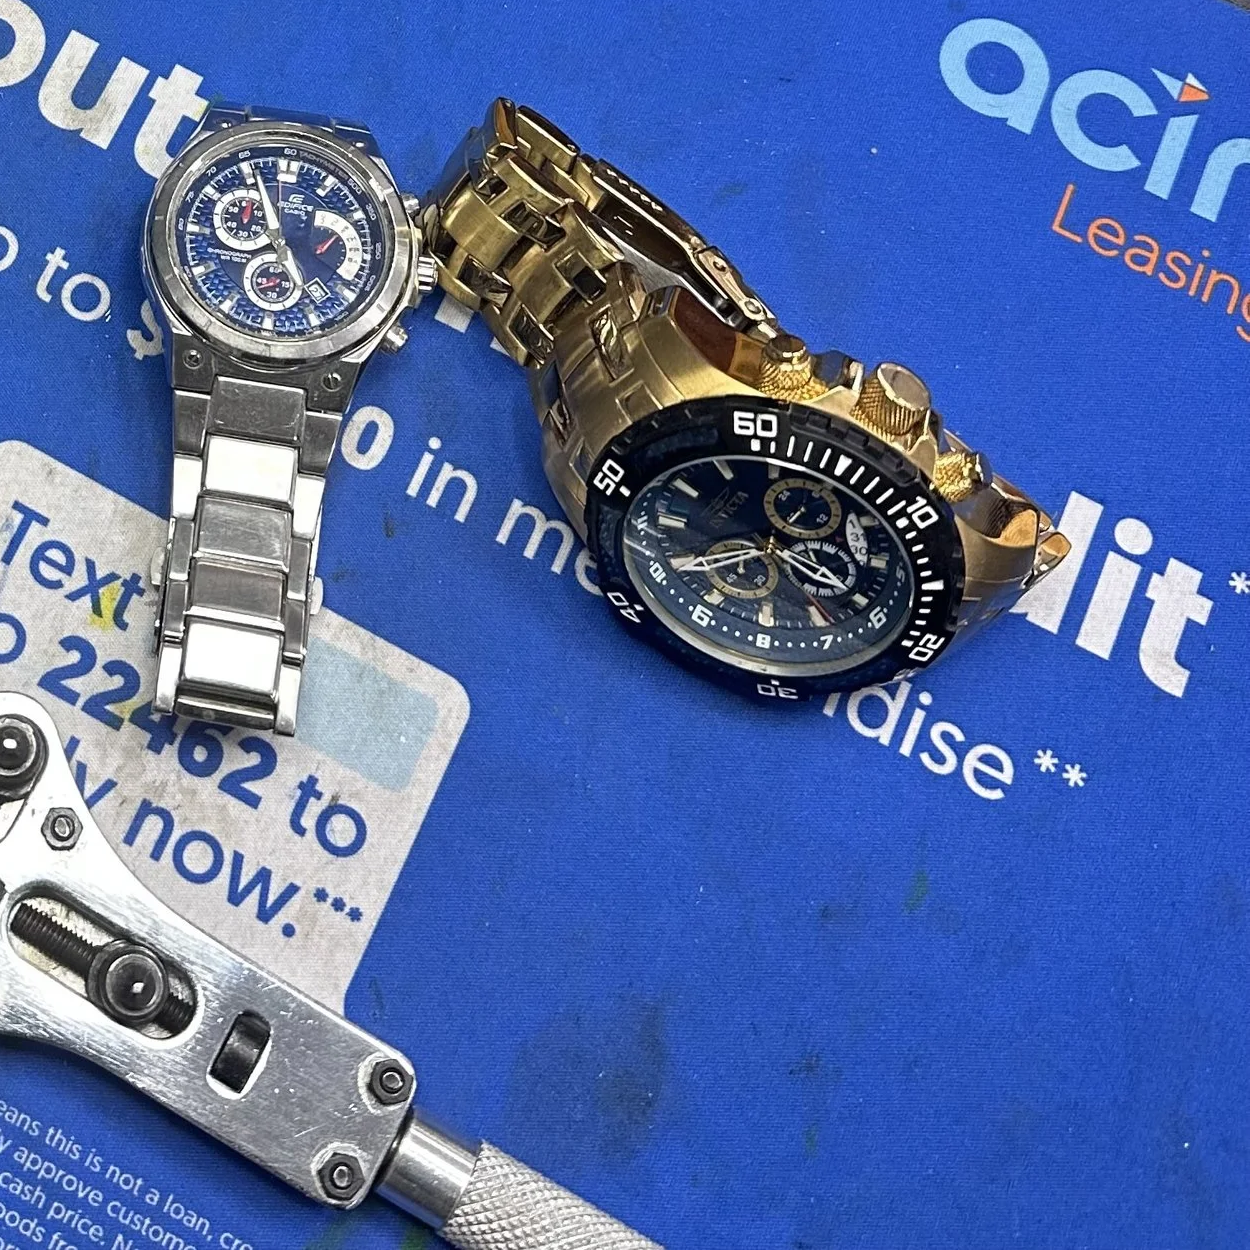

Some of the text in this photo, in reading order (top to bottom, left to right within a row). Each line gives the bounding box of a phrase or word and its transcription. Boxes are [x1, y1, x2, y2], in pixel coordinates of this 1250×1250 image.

[34, 247, 113, 323] to
[732, 410, 778, 437] 60
[405, 436, 479, 524] in
[593, 458, 625, 497] 50
[906, 495, 939, 530] 10
[288, 773, 368, 859] to
[12, 1146, 103, 1206] approve
[44, 1126, 82, 1160] this
[104, 1164, 143, 1196] not
[162, 1193, 212, 1241] loan,
[46, 1201, 105, 1245] price.
